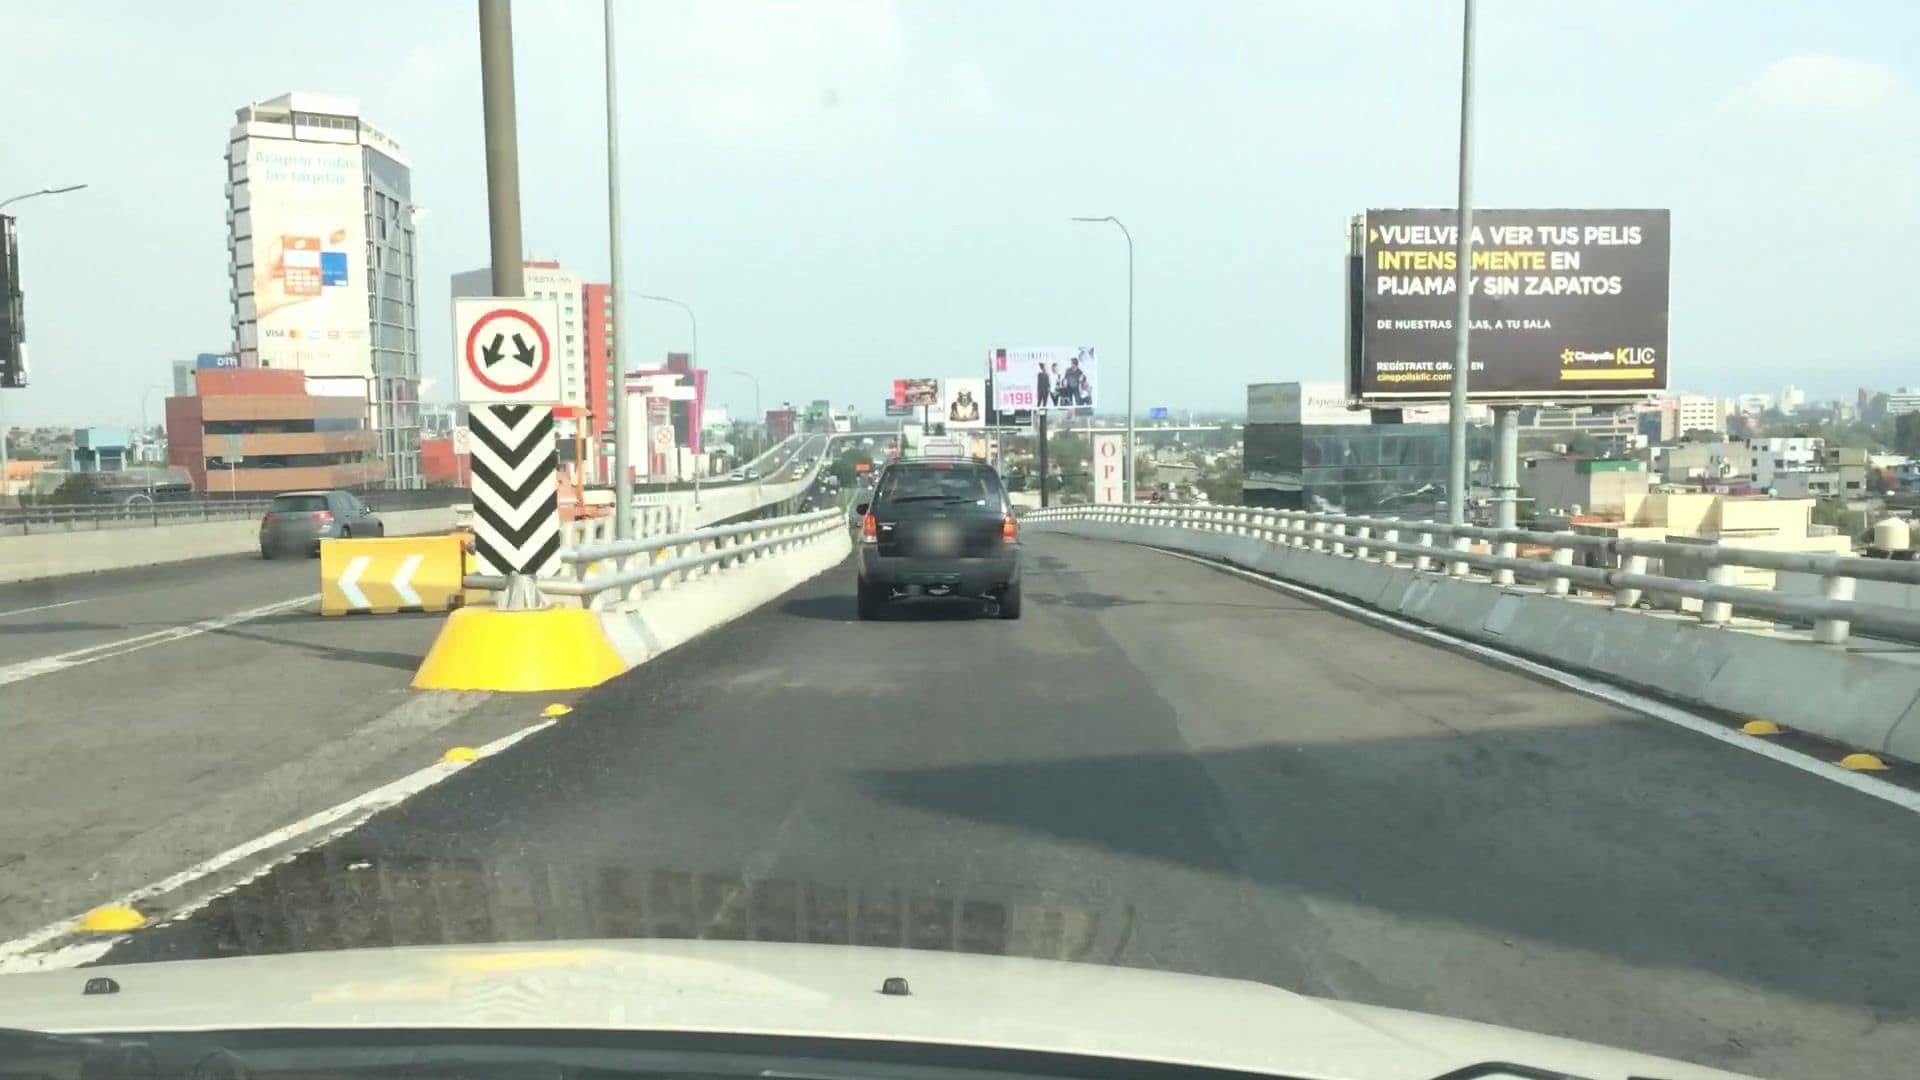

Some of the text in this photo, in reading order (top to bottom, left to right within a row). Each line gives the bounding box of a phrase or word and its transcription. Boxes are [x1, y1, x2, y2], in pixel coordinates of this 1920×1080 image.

[1379, 225, 1642, 245] VUELVE A VER TUS PELIS
[1377, 250, 1580, 270] INTENSMENTE EN
[1377, 276, 1458, 296] PIJAMA
[1483, 276, 1520, 296] SIN
[1524, 276, 1622, 296] ZAPATOS
[1376, 319, 1392, 330] DE
[1395, 319, 1453, 330] NUESTRAS
[1495, 319, 1504, 330] A
[1506, 319, 1520, 330] TU
[1523, 319, 1551, 330] SALA
[1470, 361, 1485, 371] EN
[1616, 347, 1656, 366] KLIC
